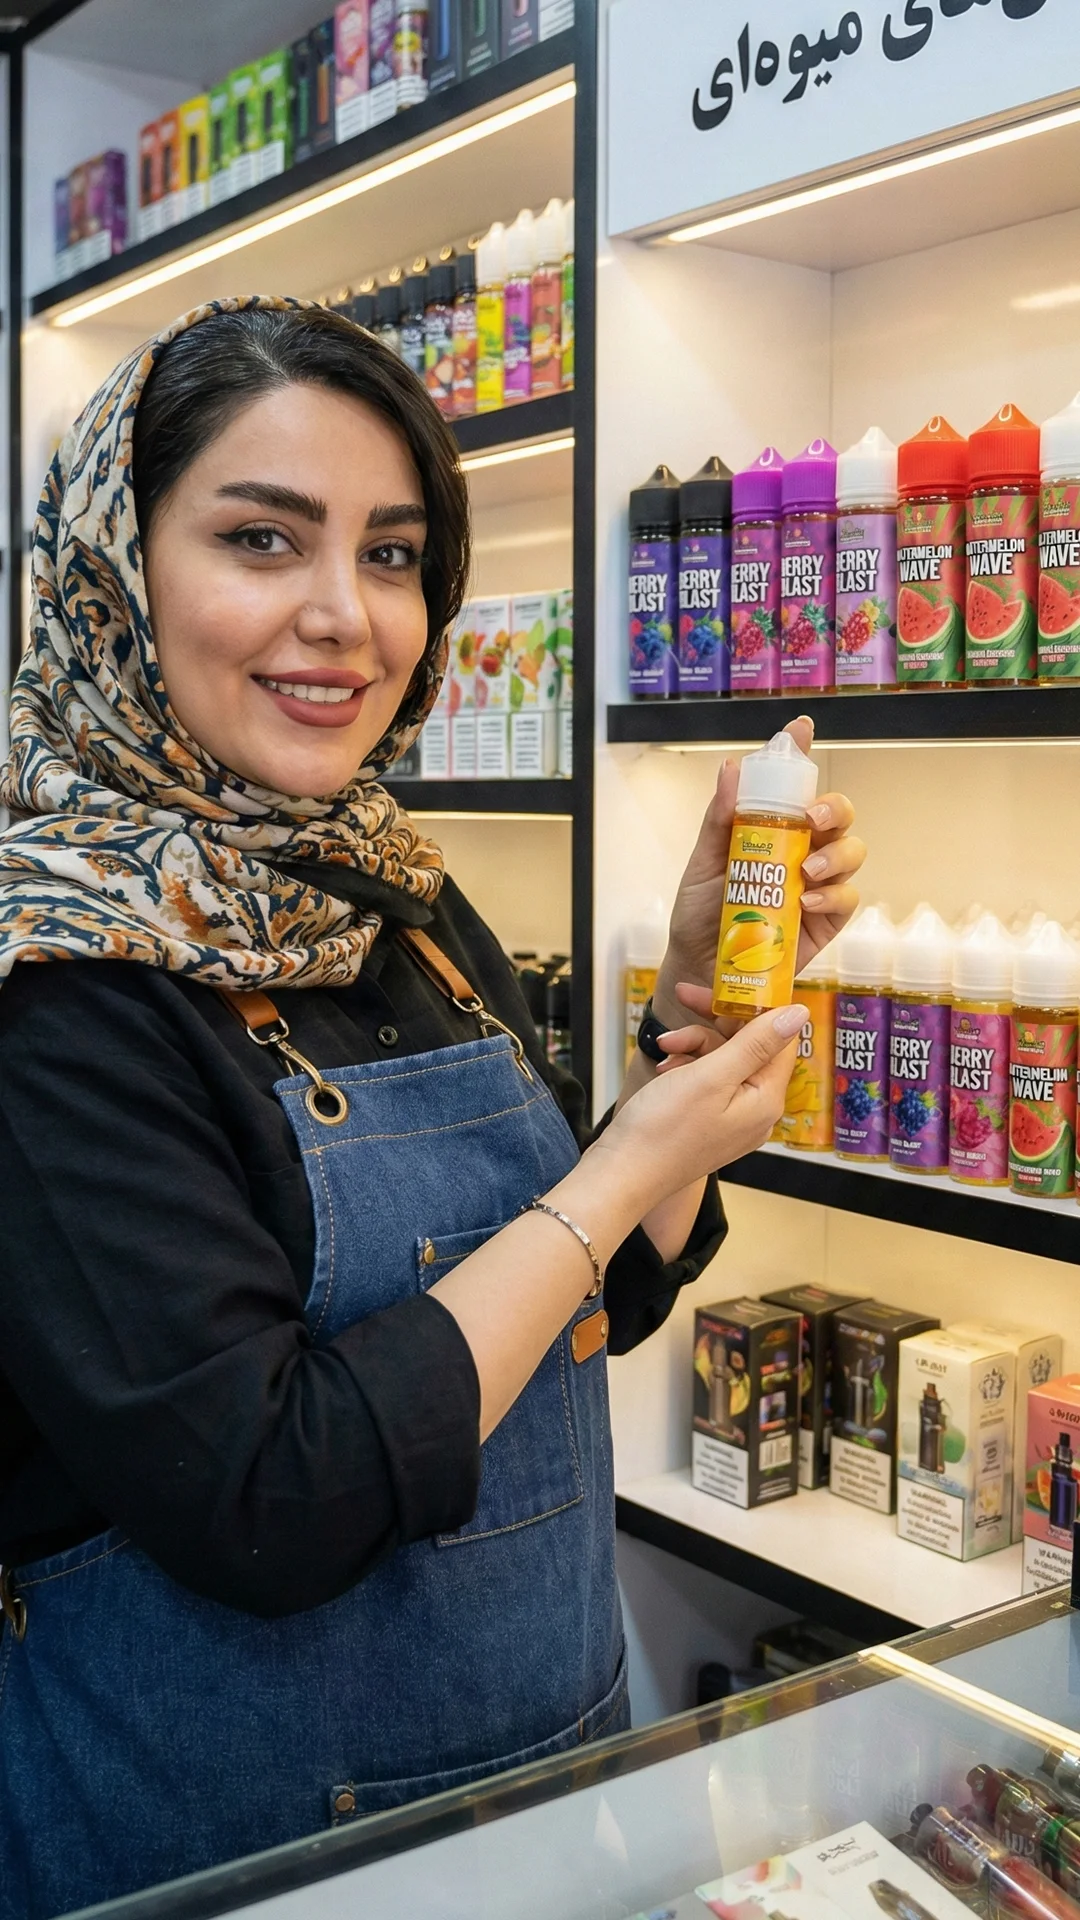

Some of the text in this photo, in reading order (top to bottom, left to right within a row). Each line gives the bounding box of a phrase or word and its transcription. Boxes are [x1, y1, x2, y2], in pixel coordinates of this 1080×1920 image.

[731, 562, 771, 583] ERRY
[900, 558, 941, 582] WAVE
[970, 553, 1013, 577] WAVE
[731, 582, 769, 603] LAST
[837, 570, 877, 593] LAST
[729, 860, 786, 887] MANGO
[726, 882, 784, 908] MANGO
[1012, 1079, 1055, 1102] WAVE
